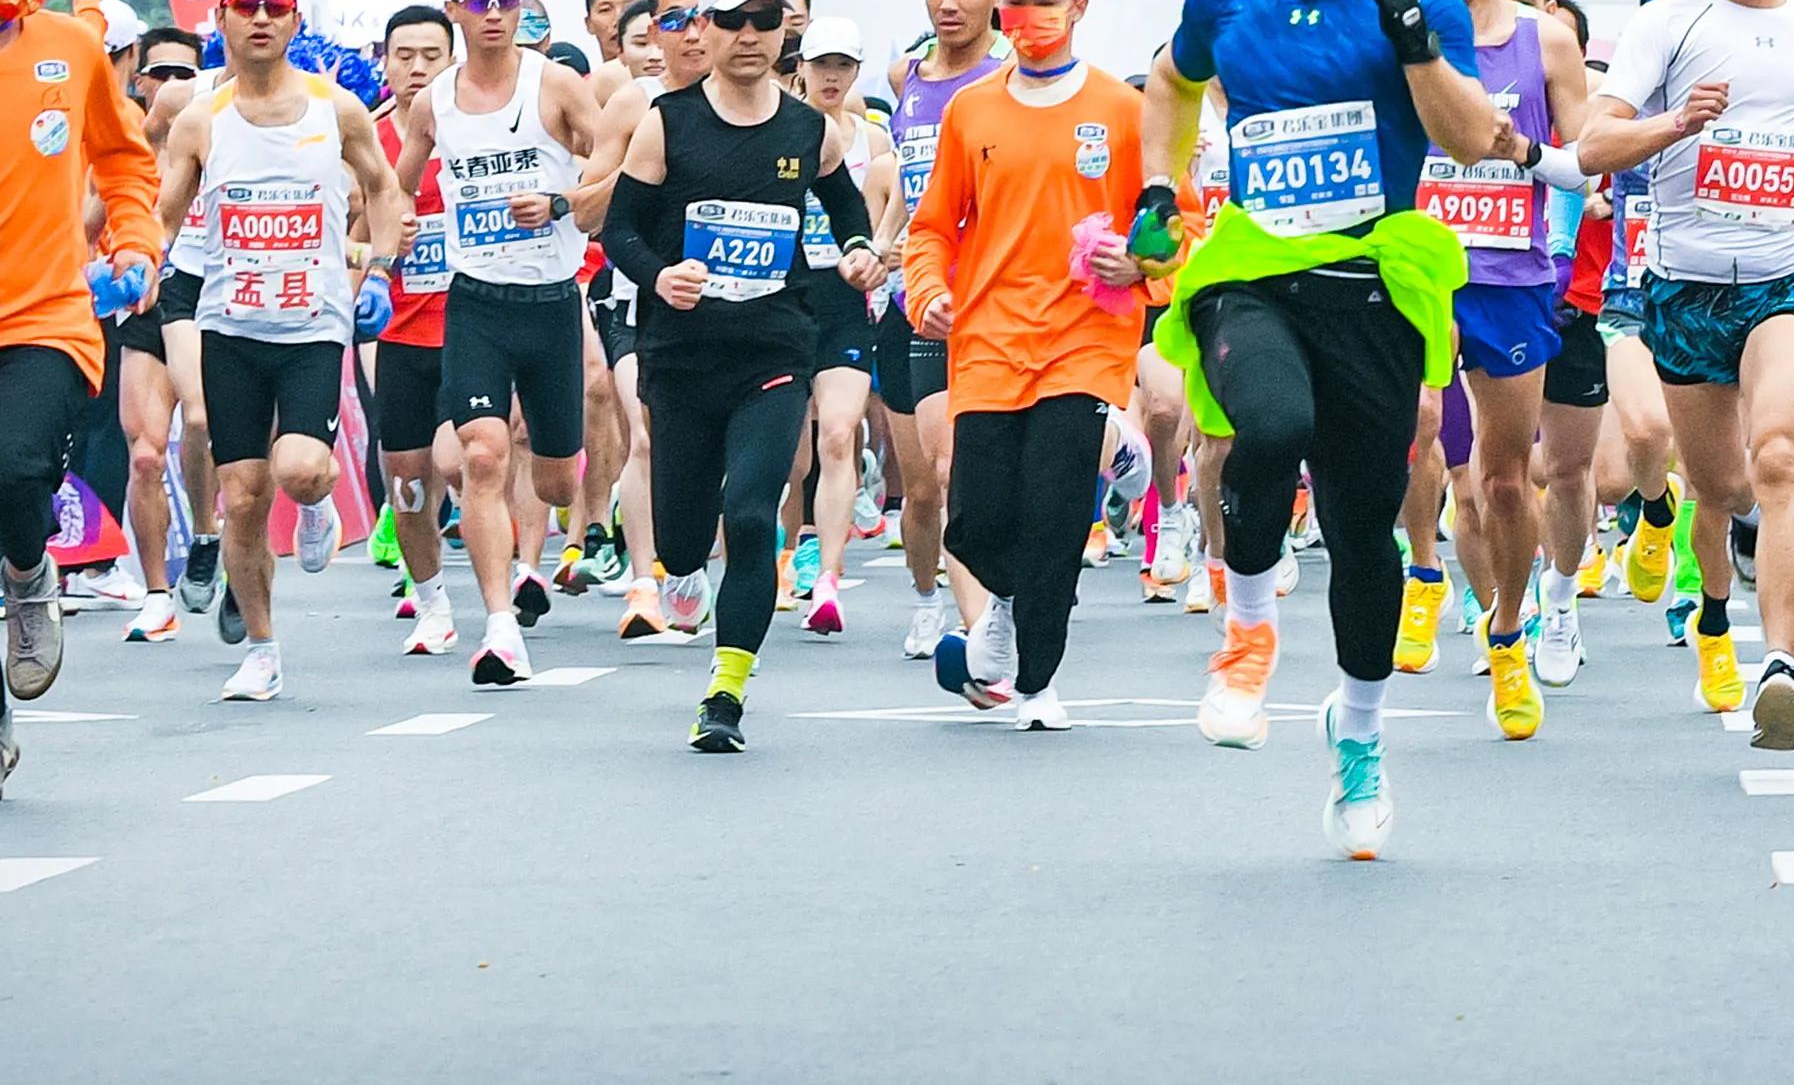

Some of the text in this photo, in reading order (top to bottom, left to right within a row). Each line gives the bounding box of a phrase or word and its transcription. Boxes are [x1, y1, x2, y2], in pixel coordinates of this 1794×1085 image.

[448, 147, 540, 180] 长春亚泰
[1247, 148, 1373, 195] A20134
[1426, 193, 1526, 224] A90915
[226, 214, 319, 240] A00034
[707, 237, 776, 267] A220
